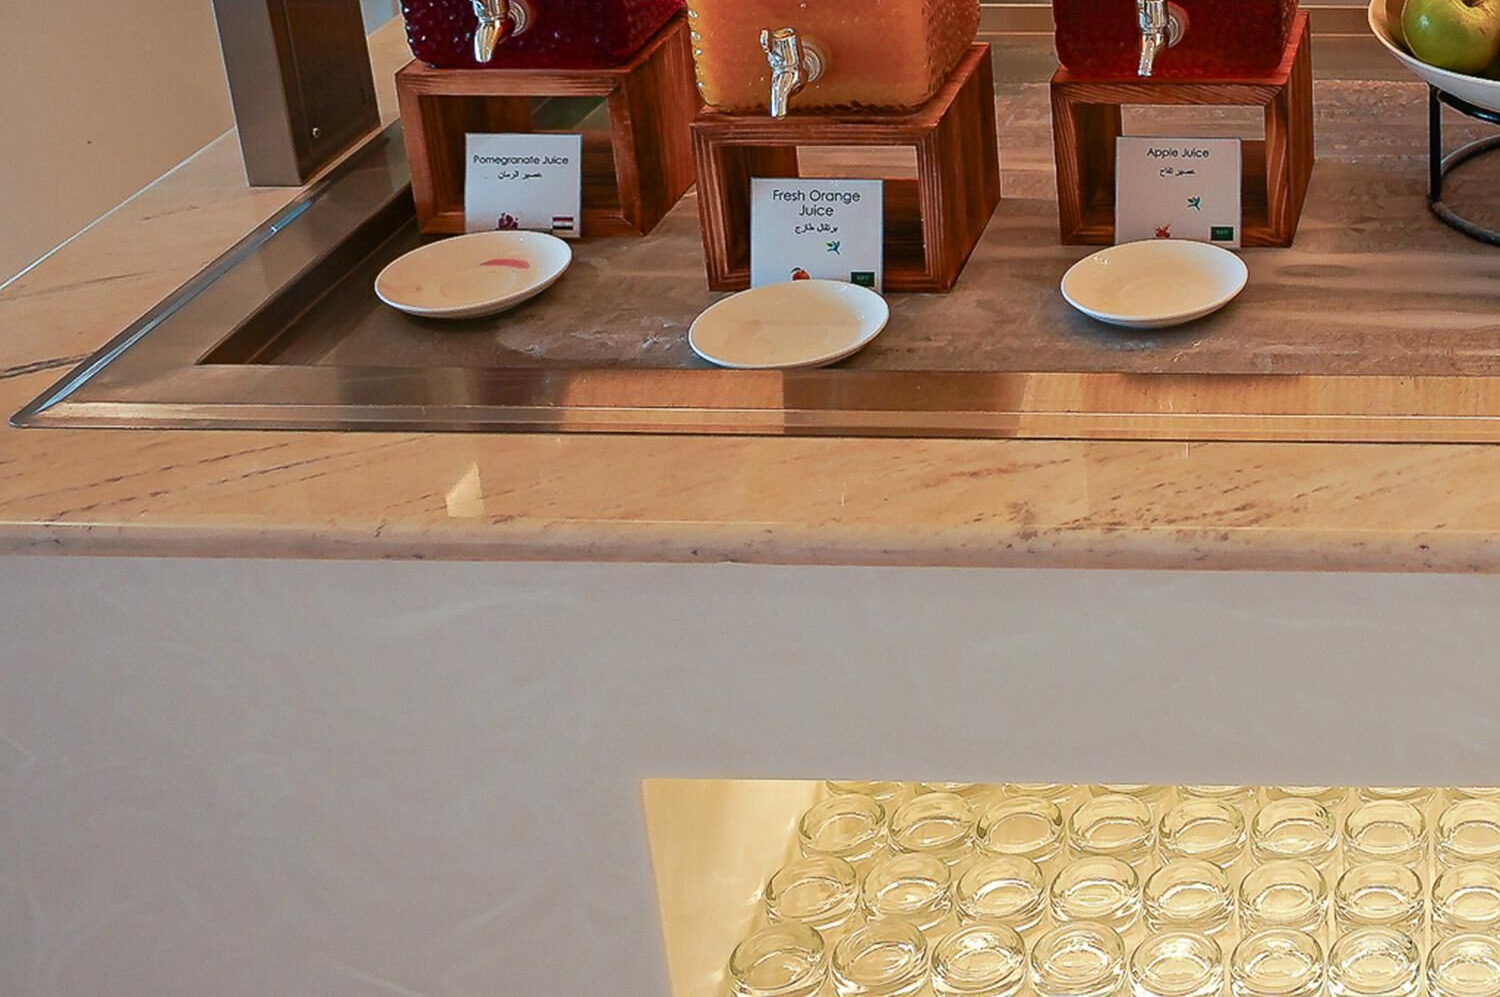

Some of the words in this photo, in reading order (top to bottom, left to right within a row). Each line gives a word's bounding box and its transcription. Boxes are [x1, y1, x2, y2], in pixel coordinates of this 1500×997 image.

[1146, 147, 1179, 159] Apple
[1181, 147, 1210, 159] Juice
[473, 154, 541, 166] Pomegranate
[542, 154, 569, 165] Juice
[772, 189, 806, 202] Fresh
[809, 189, 861, 205] Orange
[798, 204, 835, 217] Juice
